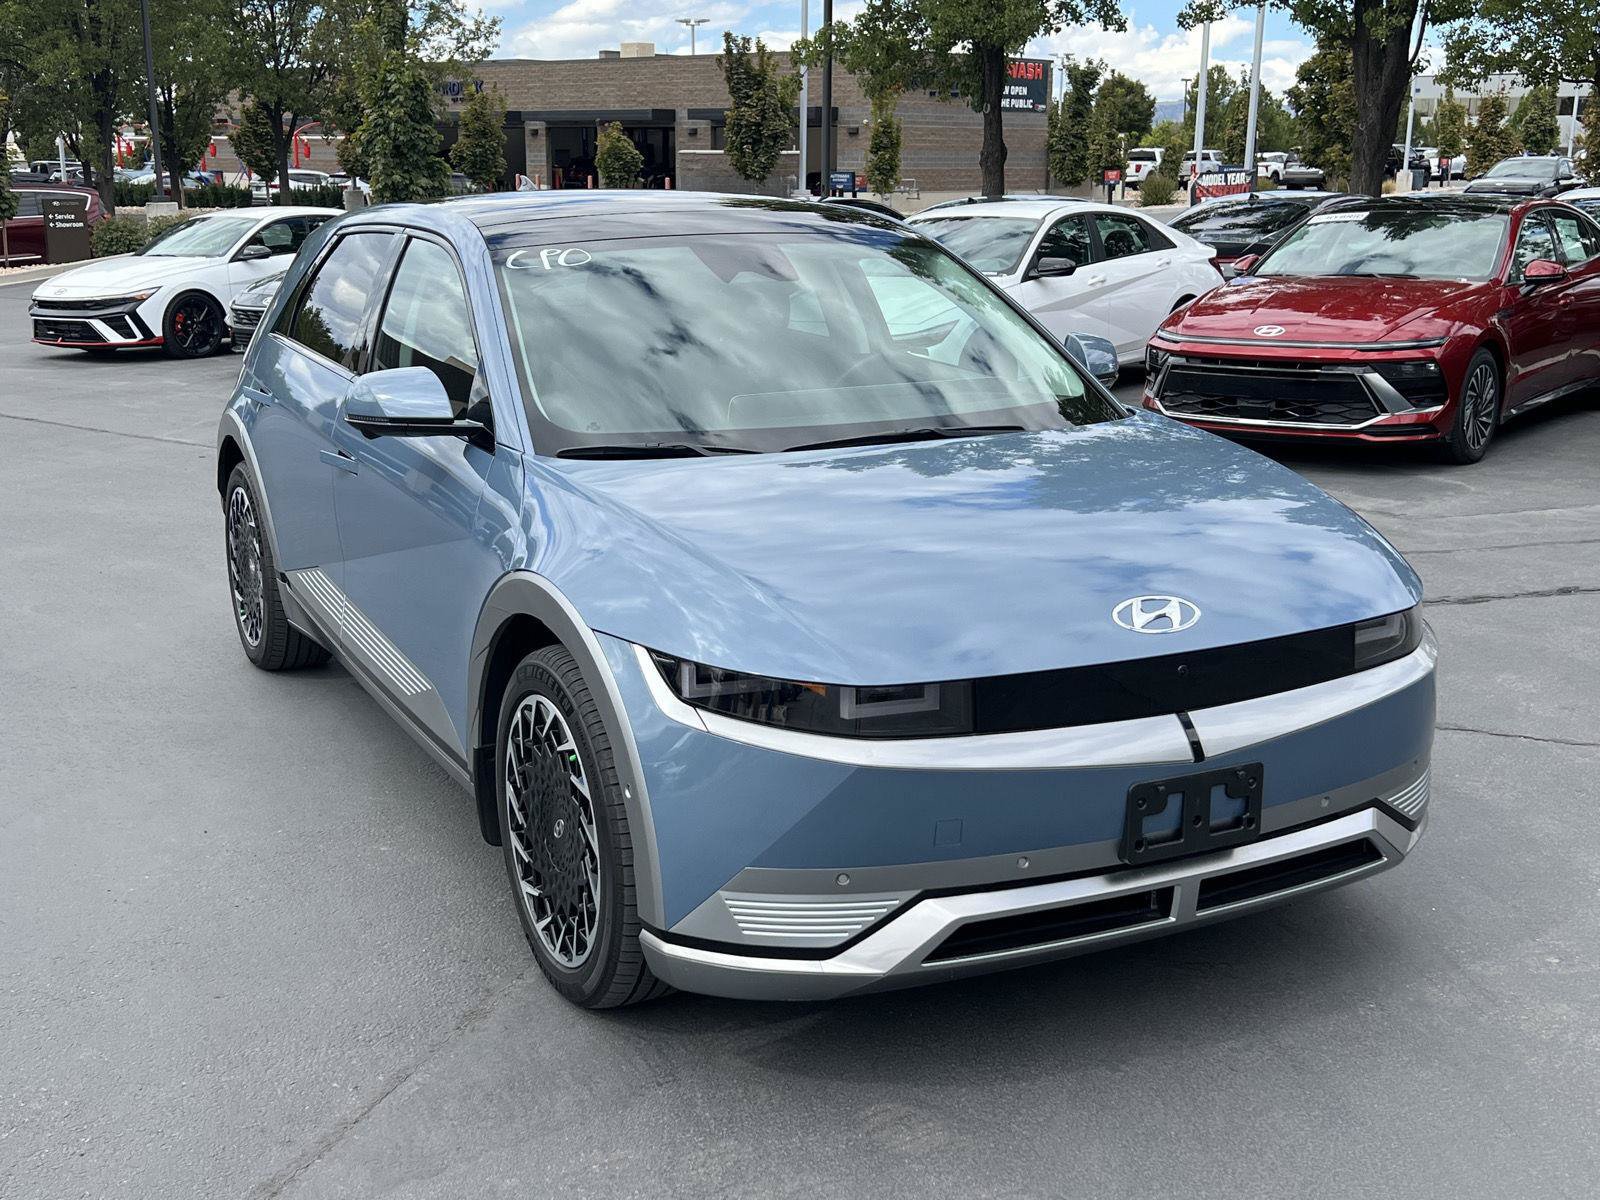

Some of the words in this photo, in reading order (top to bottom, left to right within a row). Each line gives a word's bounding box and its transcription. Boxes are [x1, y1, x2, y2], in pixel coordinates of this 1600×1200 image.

[1010, 86, 1028, 95] OPEN
[1001, 98, 1010, 108] HE
[1010, 98, 1034, 108] PUBLIC
[1202, 174, 1226, 186] MODEL
[1227, 172, 1246, 185] YEAR
[506, 248, 592, 270] CPO
